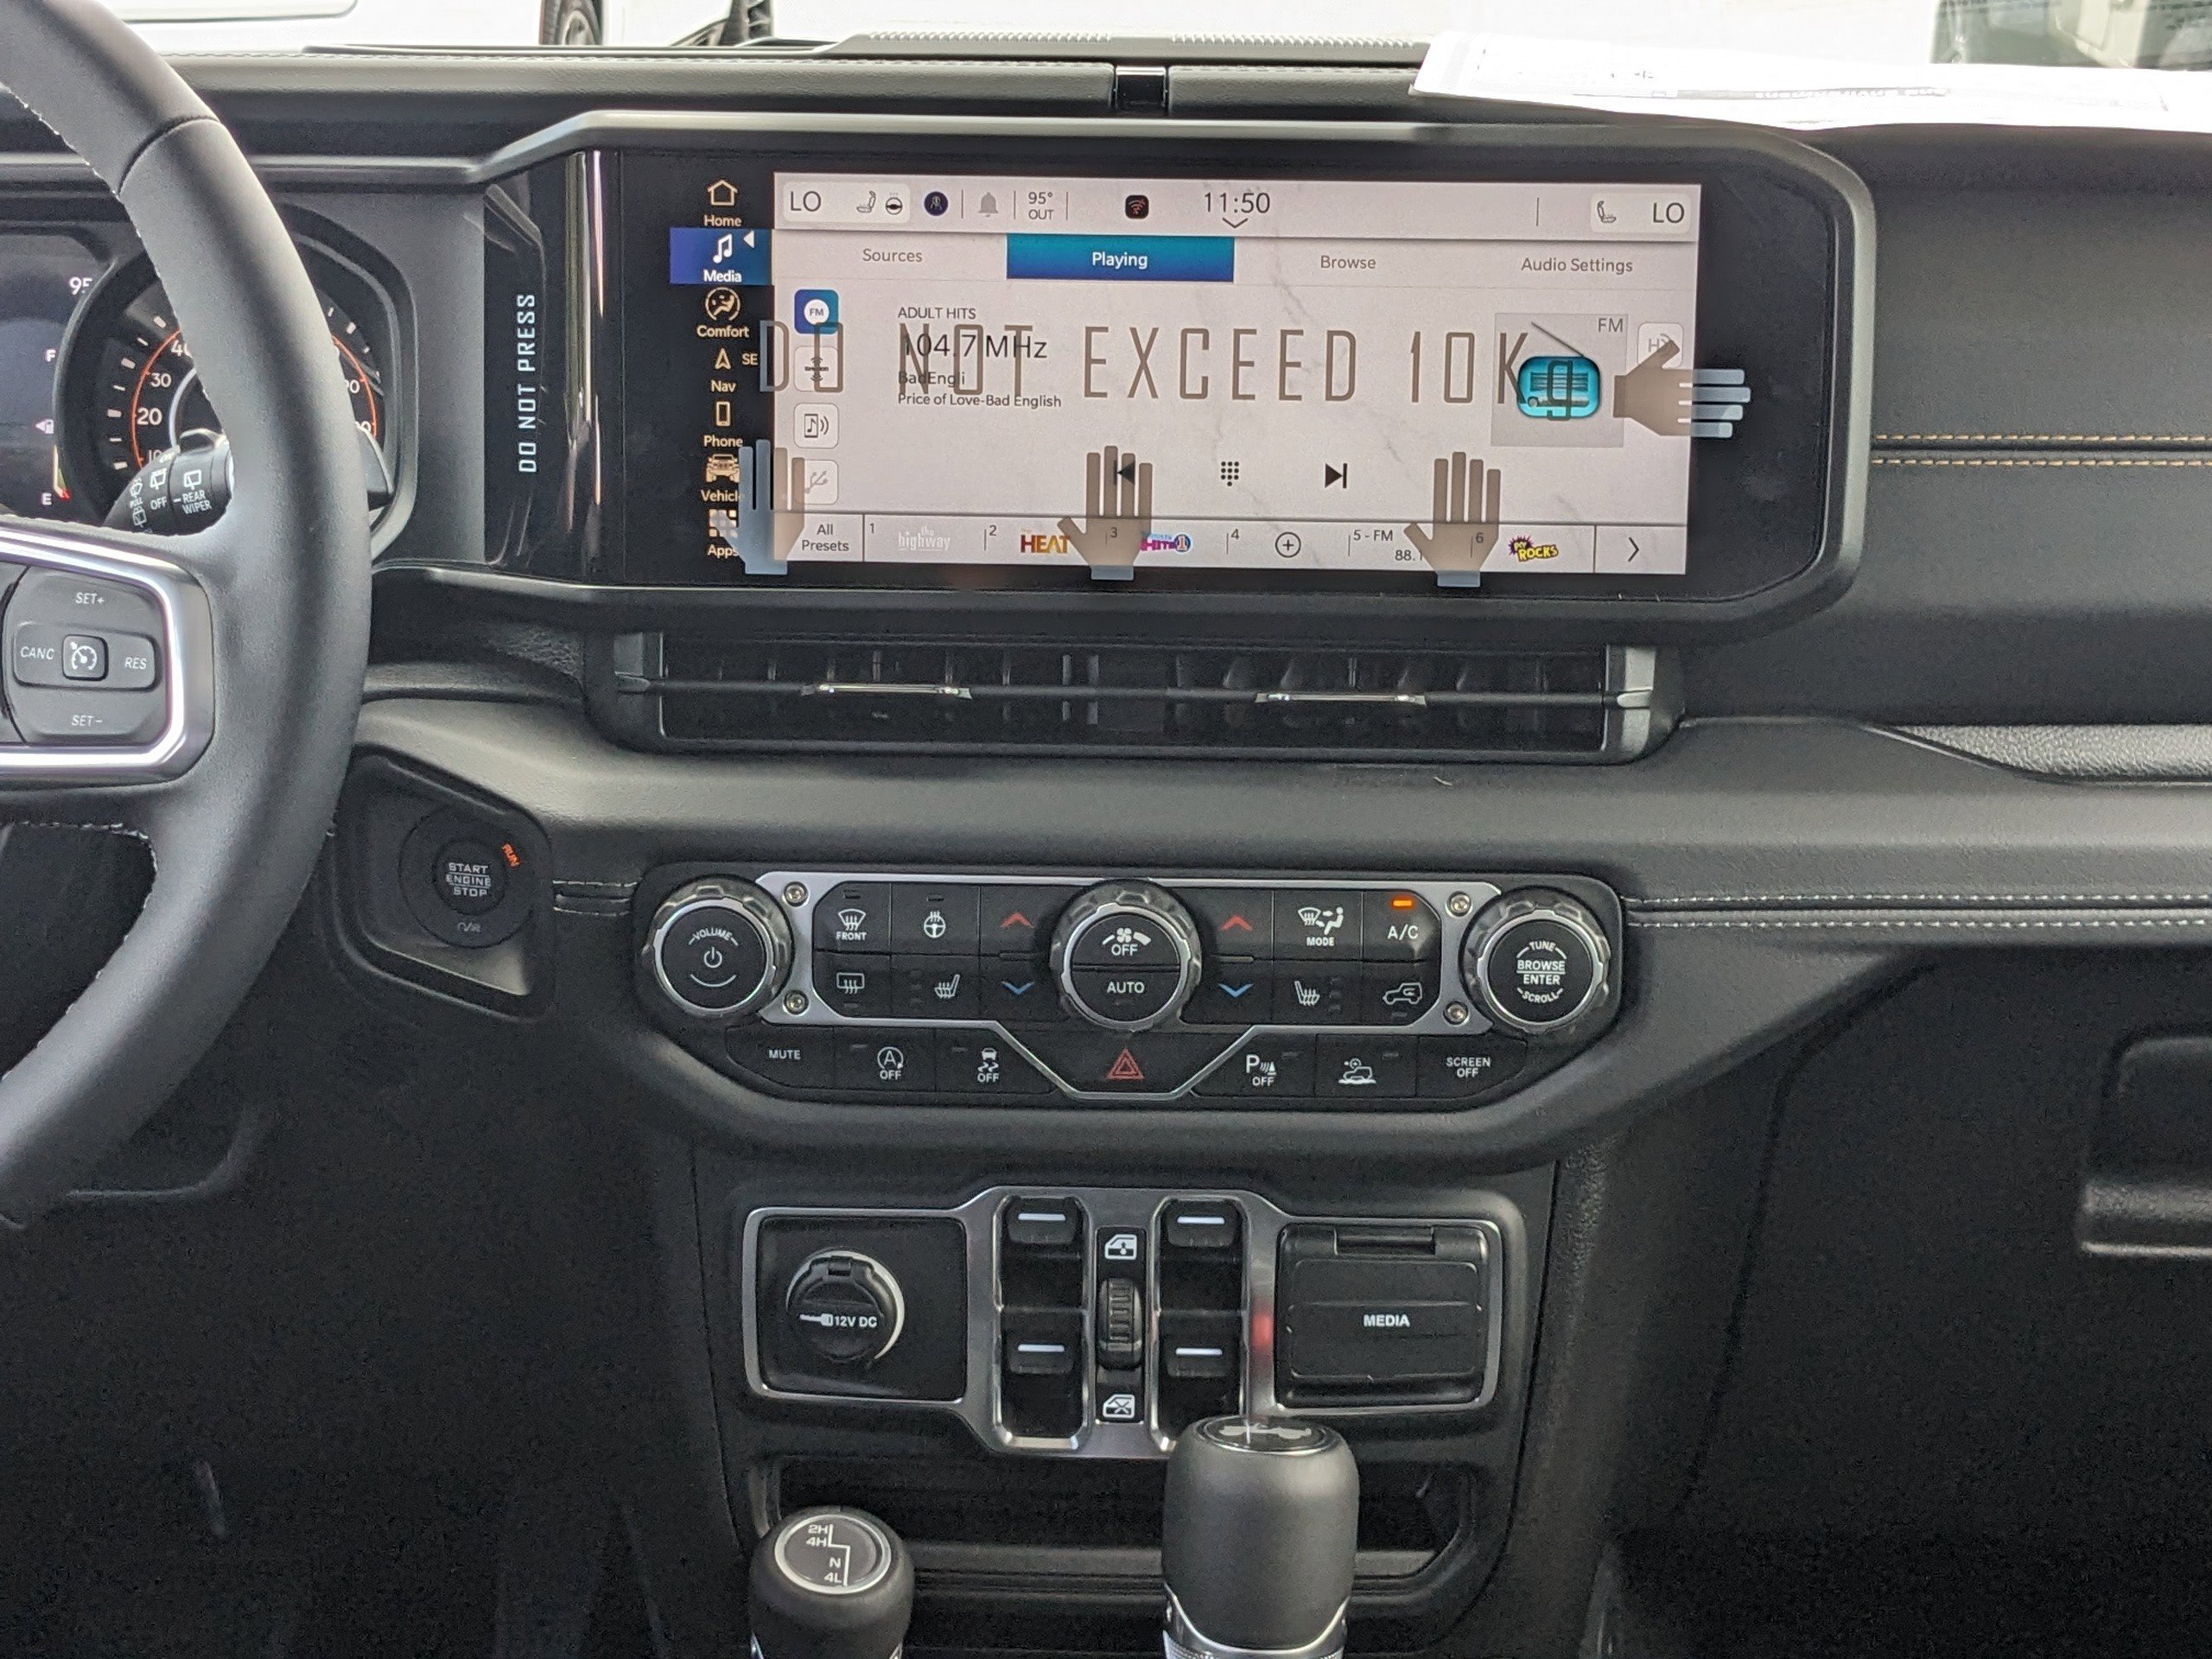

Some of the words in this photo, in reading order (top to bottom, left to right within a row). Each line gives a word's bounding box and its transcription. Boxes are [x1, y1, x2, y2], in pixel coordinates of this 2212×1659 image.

[790, 190, 822, 213] LO
[1028, 191, 1053, 205] 95°
[1204, 192, 1271, 213] 11:50
[1028, 208, 1054, 220] OUT
[1652, 202, 1685, 224] LO
[703, 214, 742, 227] Home
[862, 247, 923, 263] Sources
[1091, 251, 1148, 270] Playing
[1320, 255, 1376, 270] Browse
[1521, 257, 1567, 272] Audio
[1570, 257, 1634, 275] Settings
[702, 269, 742, 283] Media
[809, 308, 824, 317] FM
[898, 307, 943, 319] ADULT
[946, 308, 976, 320] HITS
[1598, 317, 1624, 333] FM
[517, 294, 536, 372] PRESS
[696, 325, 750, 339] Comfort
[904, 334, 976, 357] 104.7
[985, 334, 1048, 359] MHz
[46, 349, 56, 361] F
[741, 353, 759, 365] SE
[760, 320, 843, 392] DO
[899, 323, 1033, 397] NOT
[1084, 327, 1356, 402] EXCEED
[150, 372, 171, 388] 30
[345, 379, 360, 394] 0
[710, 380, 736, 392] Nav
[518, 383, 537, 429] NOT
[898, 393, 931, 405] Price
[934, 393, 948, 405] of
[950, 394, 1010, 406] Love-Bad
[1014, 395, 1062, 410] English
[137, 408, 162, 425] 20
[703, 435, 743, 448] Phone
[518, 442, 537, 473] DO
[41, 493, 52, 505] E
[182, 489, 207, 504] REAR
[149, 496, 168, 511] OFF
[182, 501, 213, 515] WIPER
[817, 523, 834, 535] All
[869, 523, 875, 534] 1
[988, 525, 997, 537] 2
[1109, 527, 1118, 538] 3
[1230, 528, 1240, 540] 4
[898, 531, 950, 551] highway
[1353, 529, 1362, 541] 5
[1373, 529, 1394, 542] FM
[1475, 532, 1484, 543] 6
[801, 540, 849, 552] Presets
[1020, 534, 1071, 554] HEAT
[707, 544, 741, 559] Apps
[75, 592, 105, 605] SET+
[21, 645, 54, 660] CANC
[124, 657, 147, 670] RES
[448, 862, 489, 874] START
[445, 874, 492, 887] ENGINE
[453, 887, 488, 897] STOP
[692, 927, 734, 942] VOLUME
[836, 931, 868, 941] FRONT
[1387, 925, 1419, 940] A/C
[1306, 937, 1335, 947] MODE
[1529, 940, 1556, 952] TUNE
[1111, 944, 1138, 957] OFF
[1517, 959, 1566, 970] BROWSE
[1522, 974, 1560, 985] ENTER
[1107, 982, 1146, 994] AUTO
[1522, 990, 1560, 1004] SCROLL
[768, 1049, 802, 1060] MUTE
[1245, 1054, 1260, 1074] P
[1446, 1058, 1491, 1068] SCREEN
[880, 1070, 901, 1080] OFF
[977, 1072, 1000, 1083] OFF
[1457, 1068, 1479, 1078] OFF
[1252, 1076, 1274, 1087] OFF
[835, 1315, 856, 1327] 12V
[859, 1315, 878, 1328] DC
[1363, 1314, 1411, 1328] MEDIA
[808, 1524, 829, 1535] 2H
[805, 1536, 827, 1547] 4H
[830, 1557, 842, 1568] N
[823, 1572, 842, 1583] 4L
